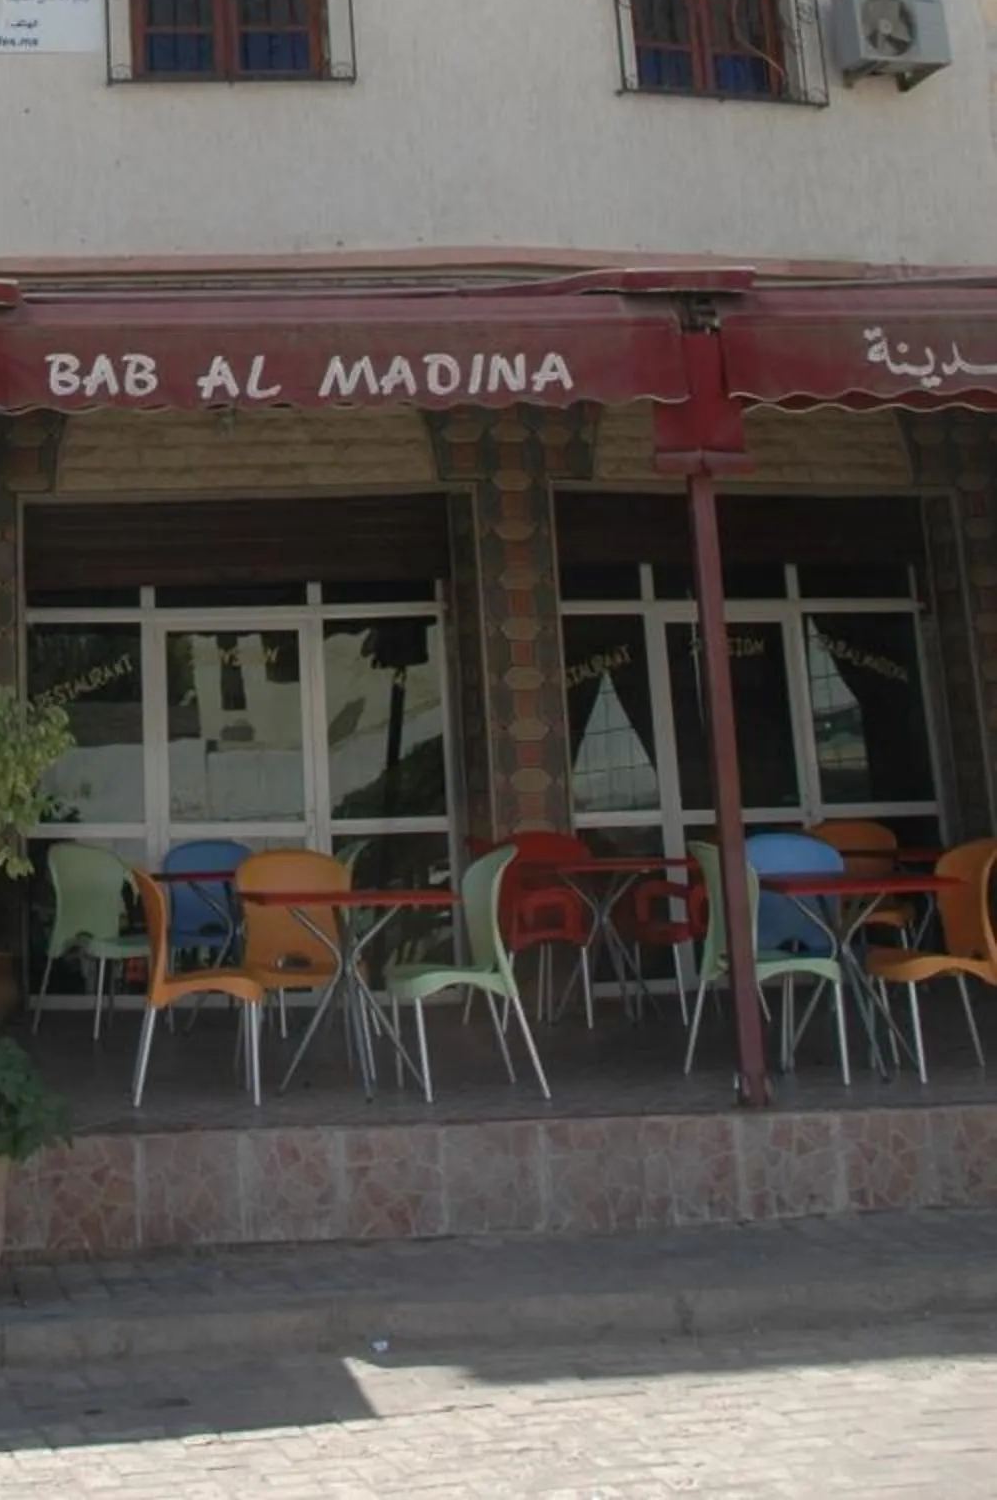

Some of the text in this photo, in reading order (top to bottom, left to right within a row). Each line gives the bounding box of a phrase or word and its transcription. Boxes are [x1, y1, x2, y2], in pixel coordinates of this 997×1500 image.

[44, 352, 575, 401] BAB AL MADINA
